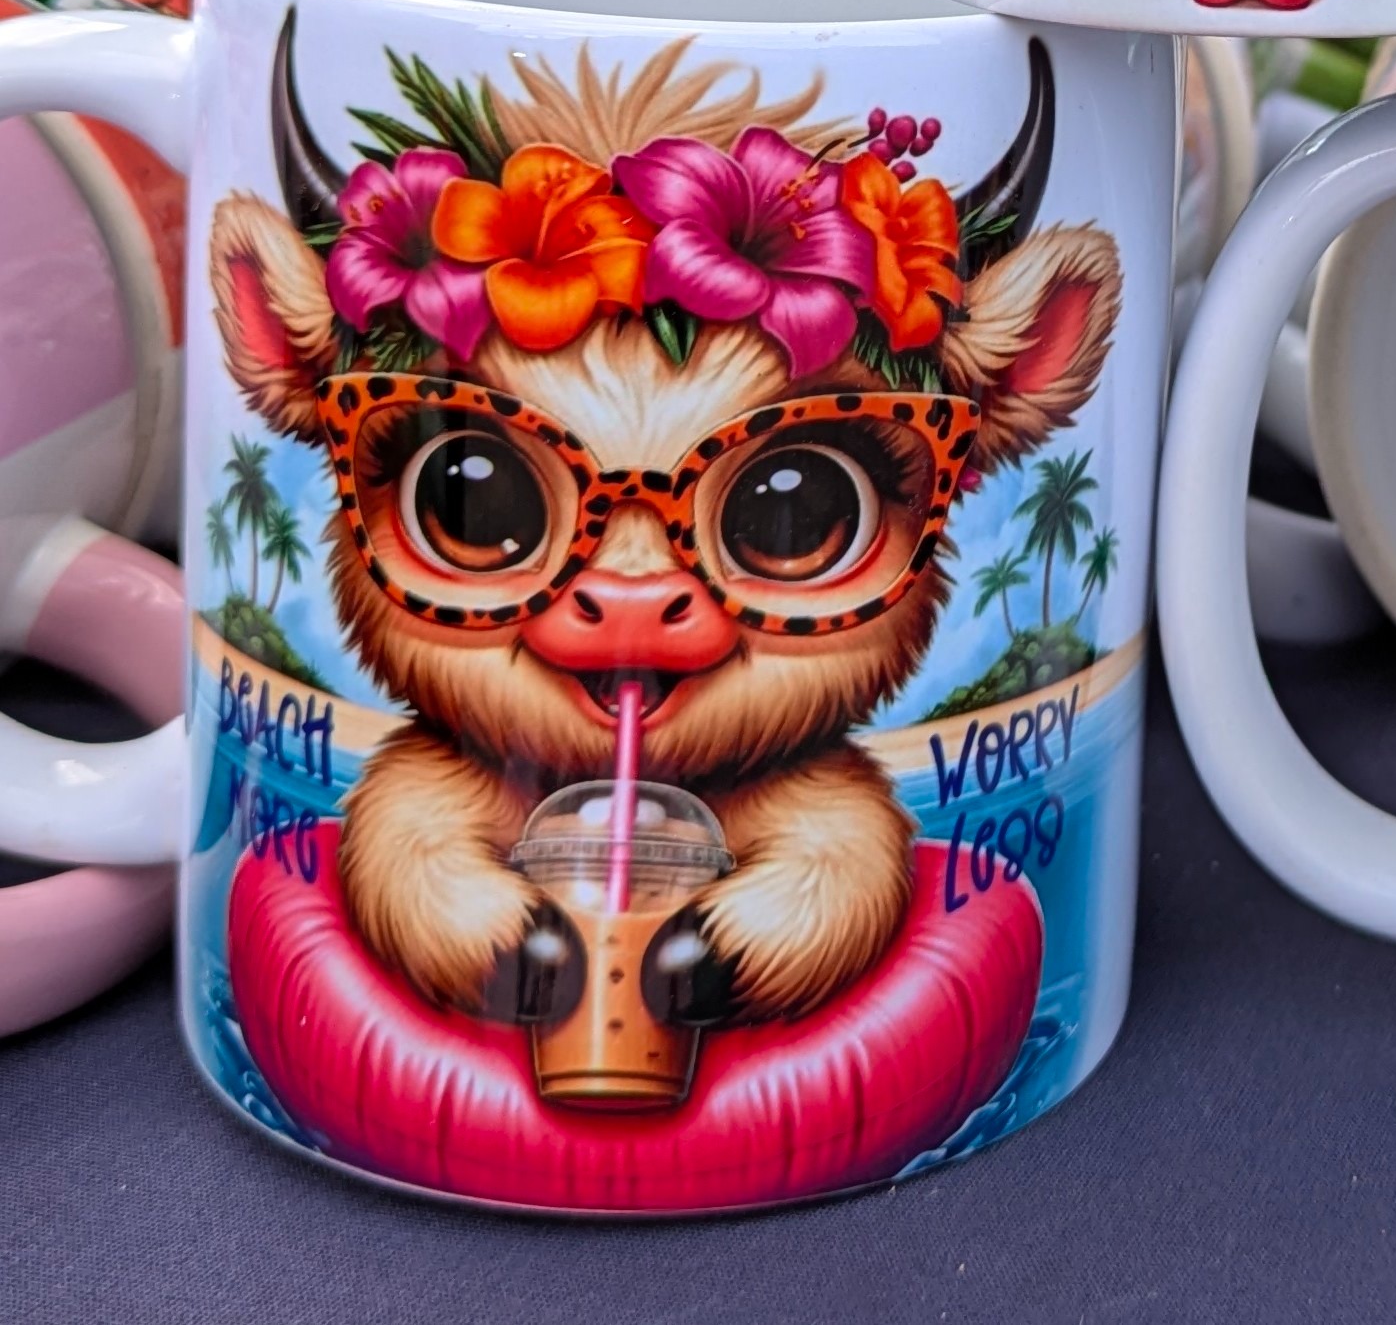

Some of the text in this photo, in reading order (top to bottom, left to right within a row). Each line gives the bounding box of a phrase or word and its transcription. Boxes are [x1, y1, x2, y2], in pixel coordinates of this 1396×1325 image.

[219, 655, 334, 787] BEACH
[930, 683, 1080, 808] WORRY
[229, 762, 319, 884] MORE
[945, 793, 1064, 913] LESS
